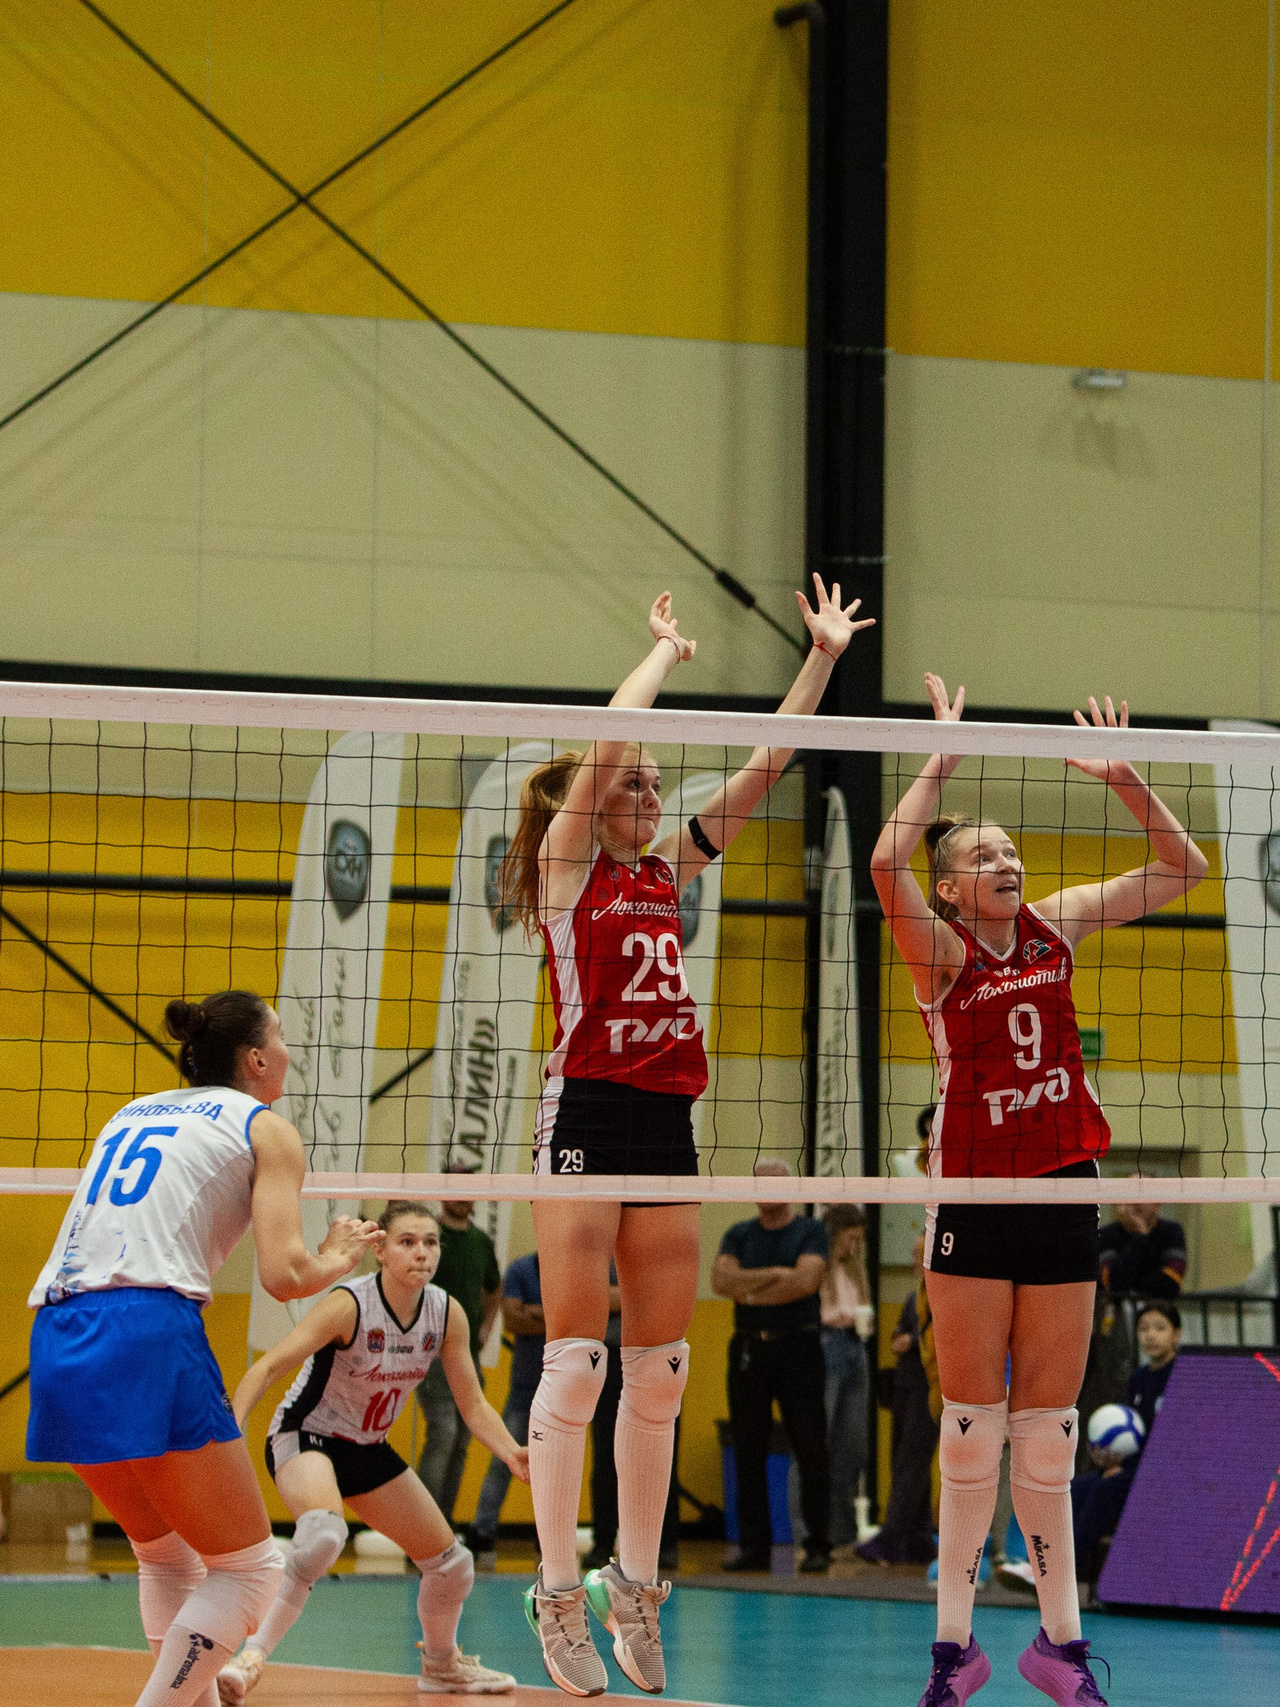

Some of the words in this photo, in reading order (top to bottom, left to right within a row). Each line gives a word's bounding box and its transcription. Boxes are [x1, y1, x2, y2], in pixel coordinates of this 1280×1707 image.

[621, 932, 689, 1001] 29
[960, 957, 1067, 1010] Локомотив
[1008, 1003, 1042, 1070] 9
[85, 1126, 179, 1207] 15
[559, 1149, 584, 1173] 29
[941, 1232, 954, 1256] 9
[361, 1388, 402, 1432] 10
[967, 1547, 983, 1585] MIKASA
[1030, 1535, 1049, 1577] MIKASA
